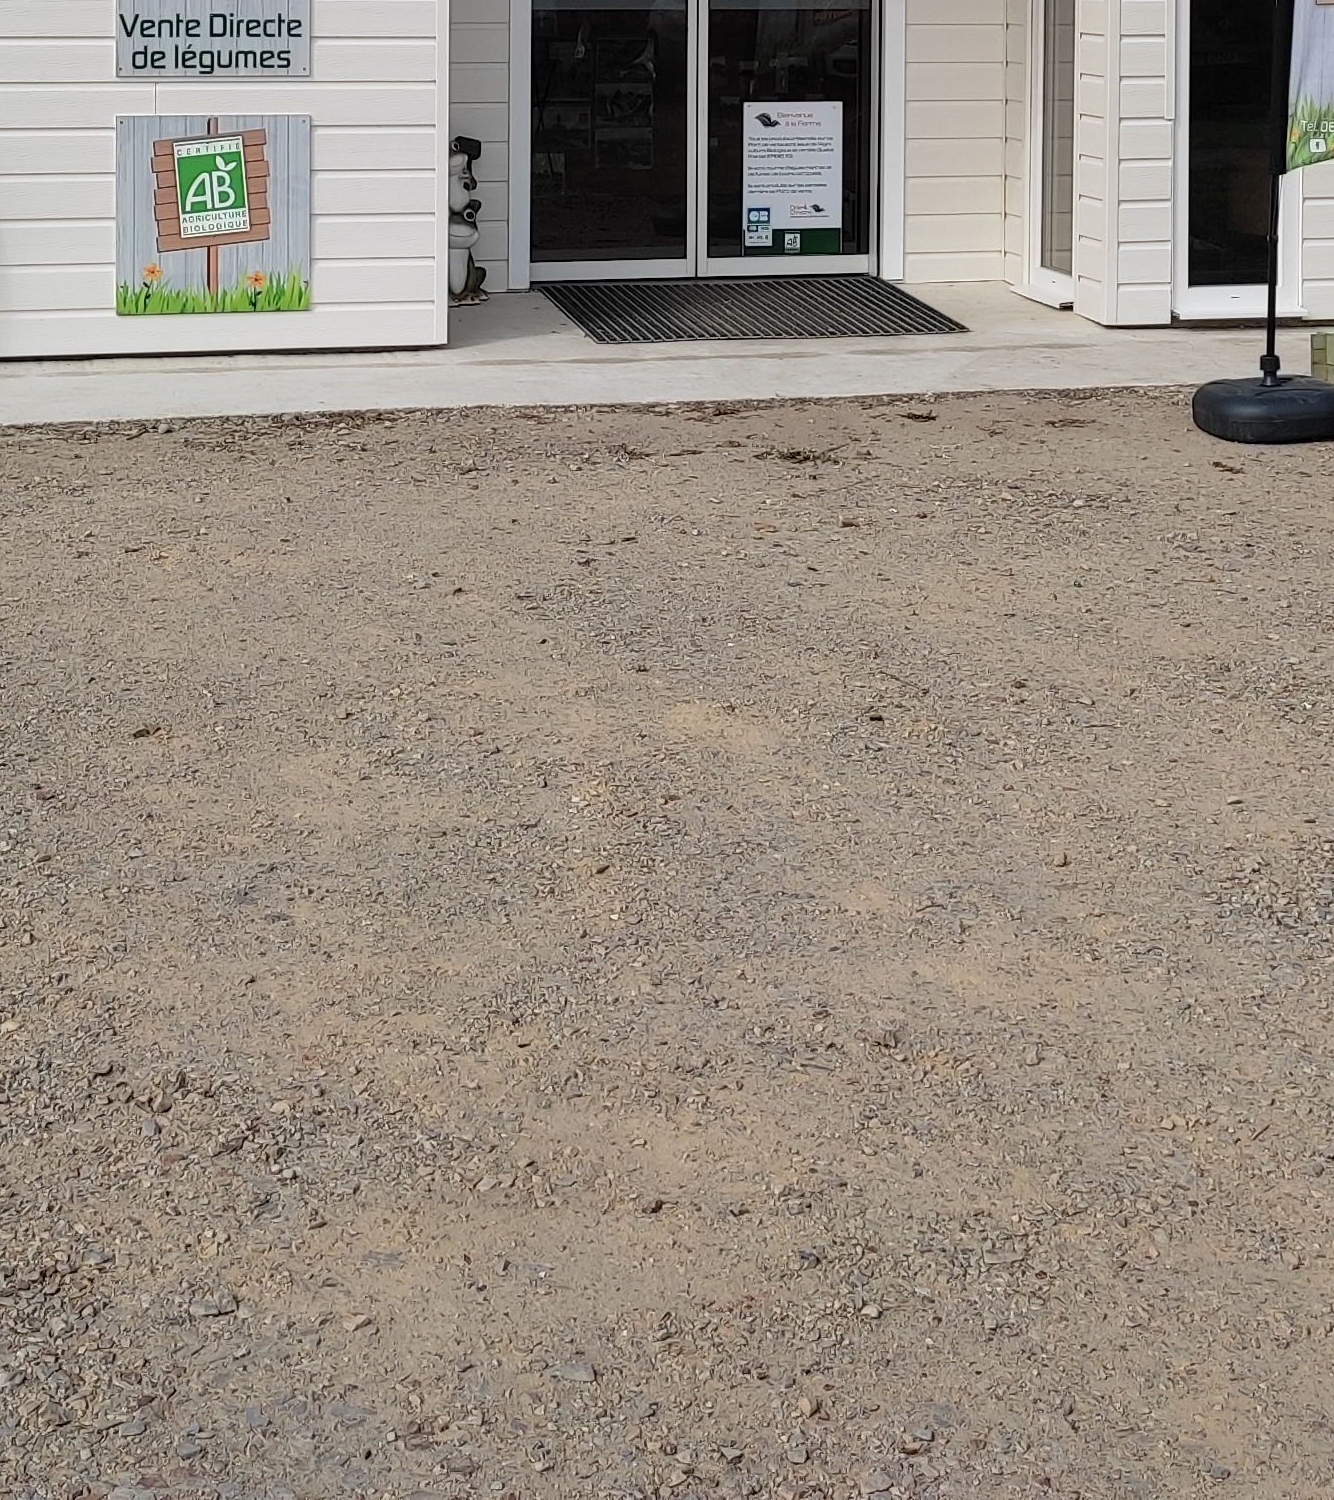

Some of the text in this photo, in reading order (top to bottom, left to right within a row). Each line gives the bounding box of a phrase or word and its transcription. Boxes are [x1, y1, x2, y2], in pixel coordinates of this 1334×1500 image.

[119, 12, 302, 38] Vente Directe
[131, 43, 291, 75] de légumes
[185, 170, 235, 212] AB
[182, 210, 247, 224] AGRICULTURE
[183, 219, 248, 234] BIOLOGIQUE
